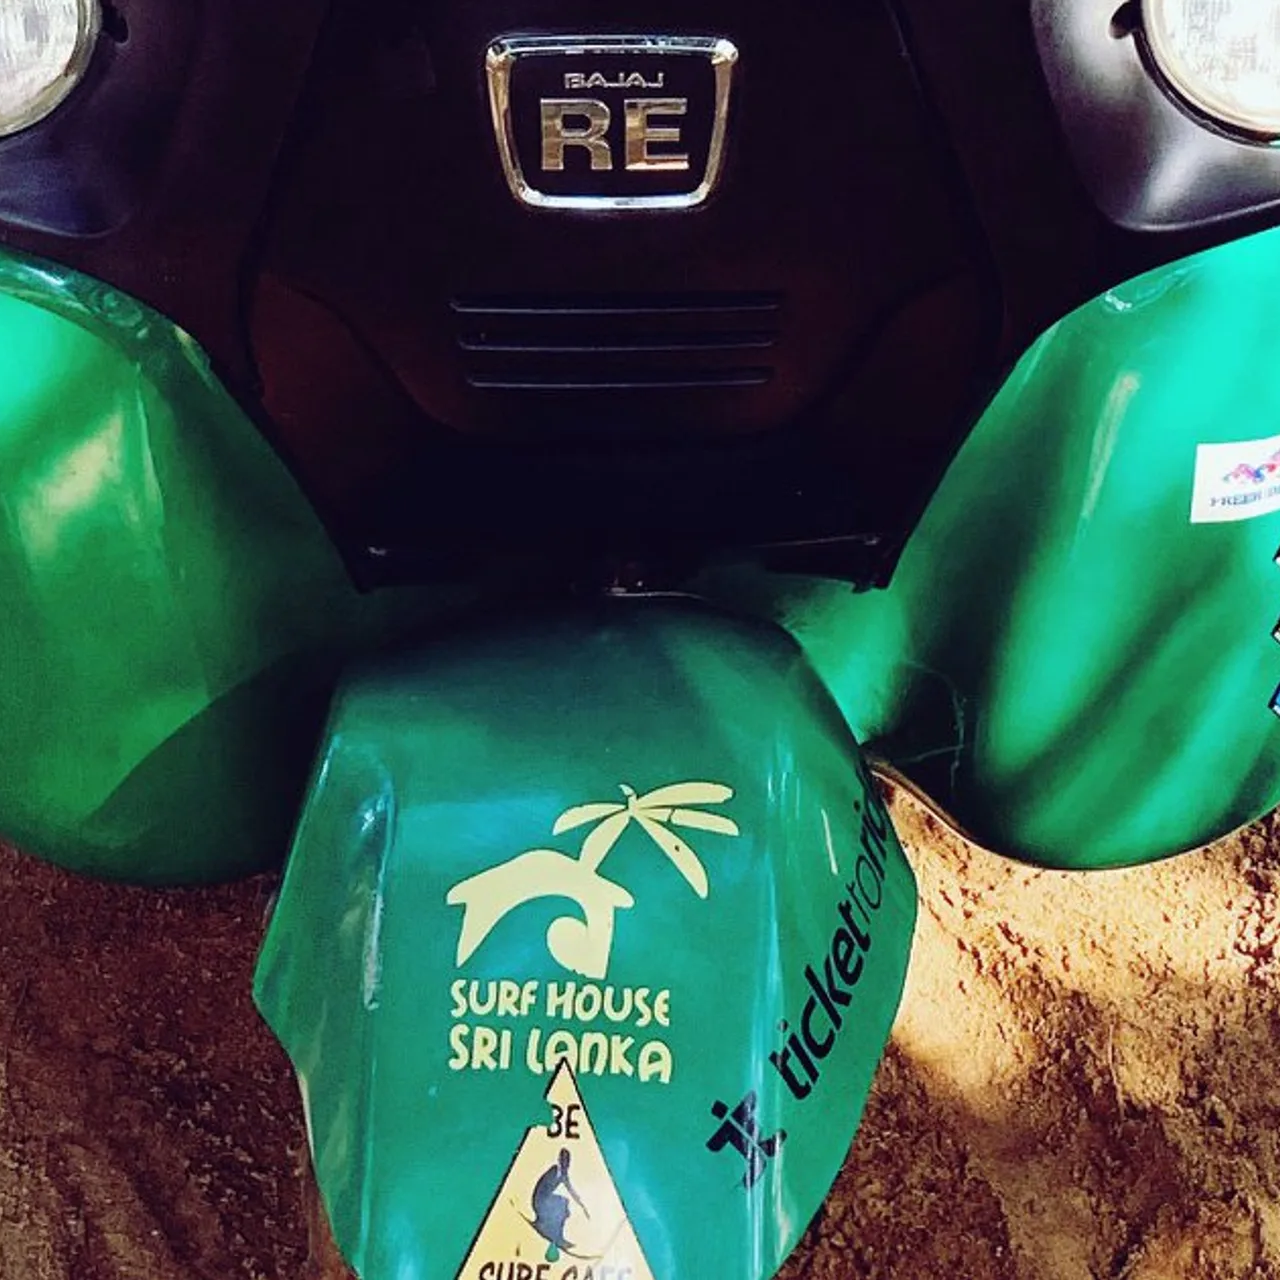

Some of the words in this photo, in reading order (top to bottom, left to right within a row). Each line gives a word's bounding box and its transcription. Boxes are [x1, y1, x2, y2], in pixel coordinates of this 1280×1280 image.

[564, 72, 664, 89] BAJAJ
[540, 97, 690, 170] RE
[450, 978, 539, 1017] SURF
[546, 980, 670, 1027] HOUSE
[448, 1023, 512, 1070] SRI
[526, 1027, 673, 1084] LANKA
